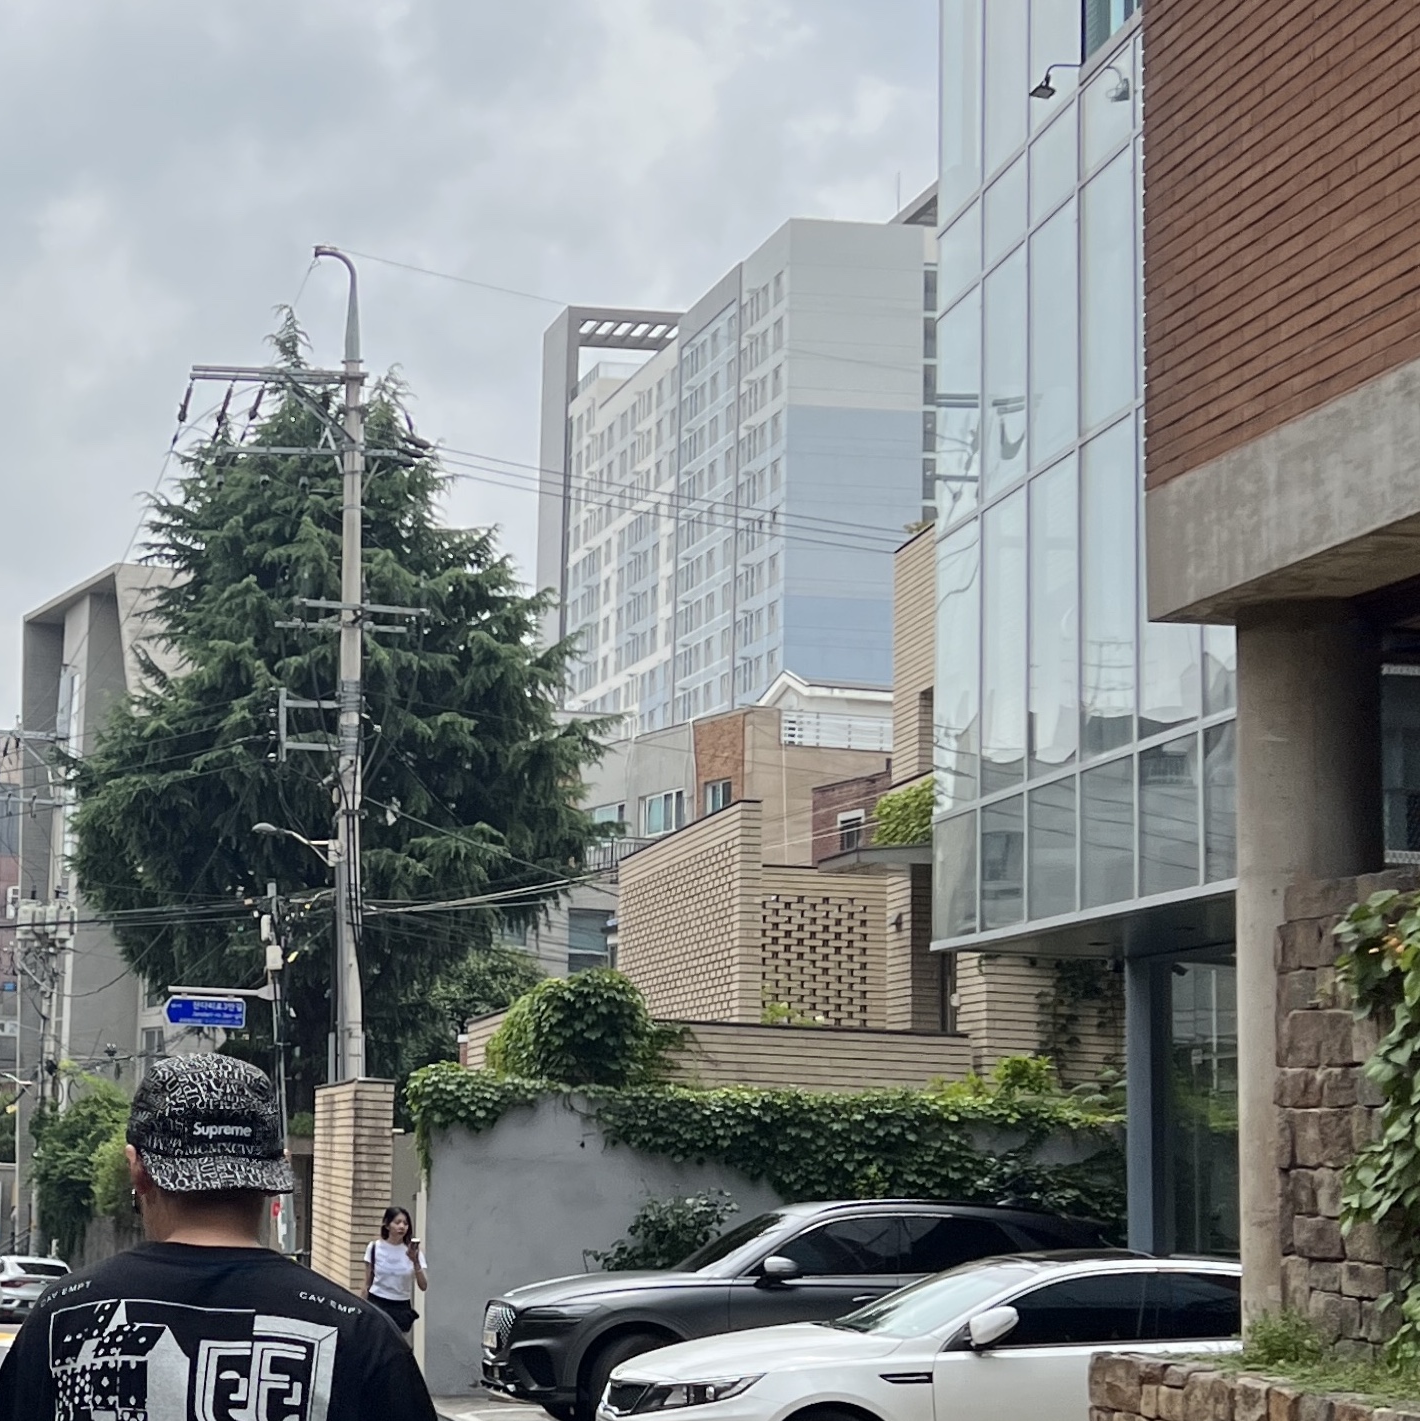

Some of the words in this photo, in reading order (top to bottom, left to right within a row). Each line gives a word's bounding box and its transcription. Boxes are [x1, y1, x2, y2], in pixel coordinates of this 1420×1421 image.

[193, 1122, 252, 1139] Supreme
[61, 1280, 92, 1296] EMPT
[299, 1291, 325, 1304] CAV
